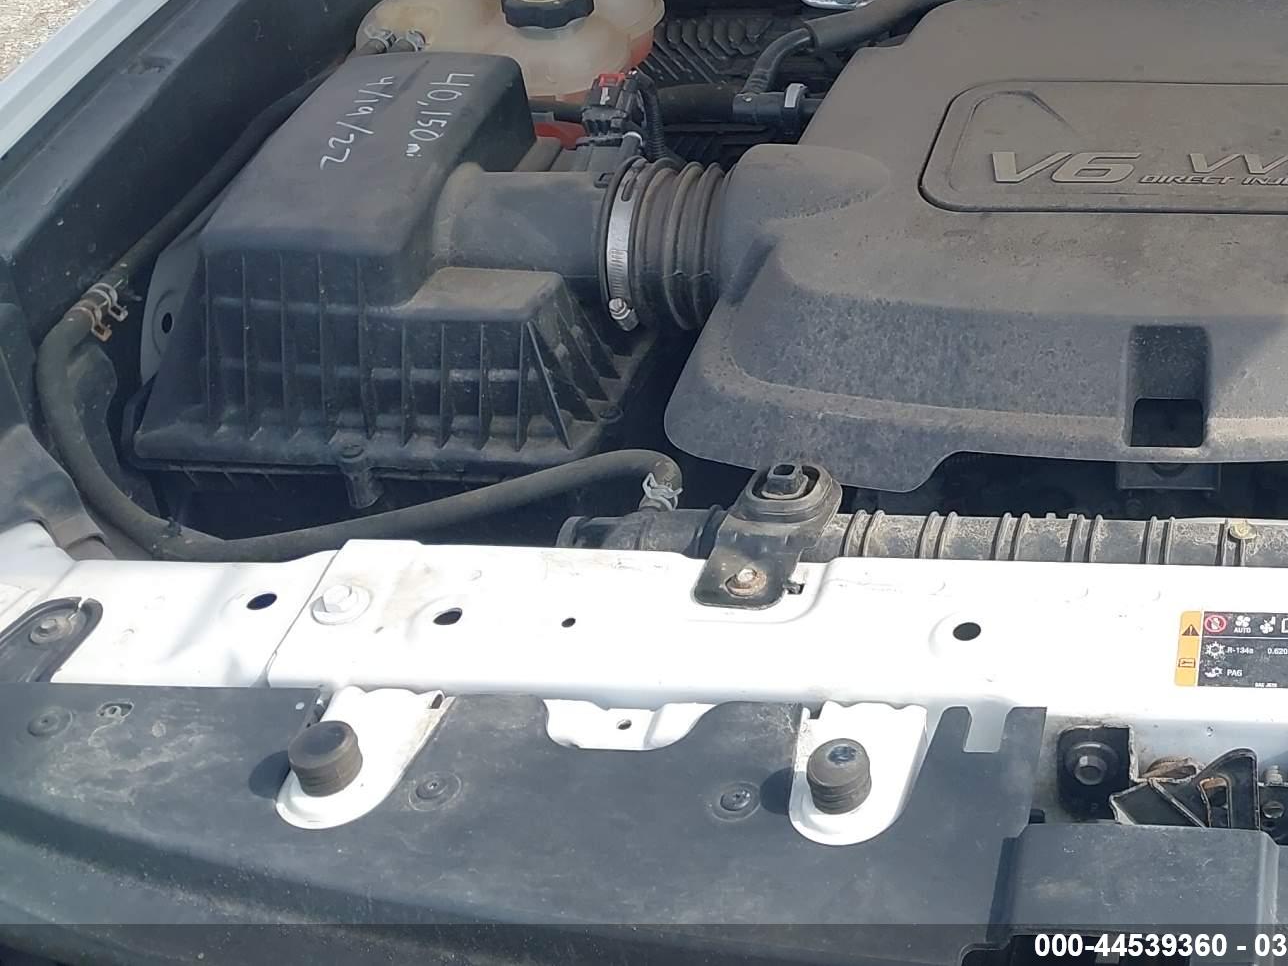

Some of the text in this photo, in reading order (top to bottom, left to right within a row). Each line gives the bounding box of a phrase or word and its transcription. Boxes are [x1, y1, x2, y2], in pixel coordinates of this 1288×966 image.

[990, 150, 1142, 184] V6
[1139, 174, 1236, 185] DIRECT
[1227, 646, 1254, 654] R-134a
